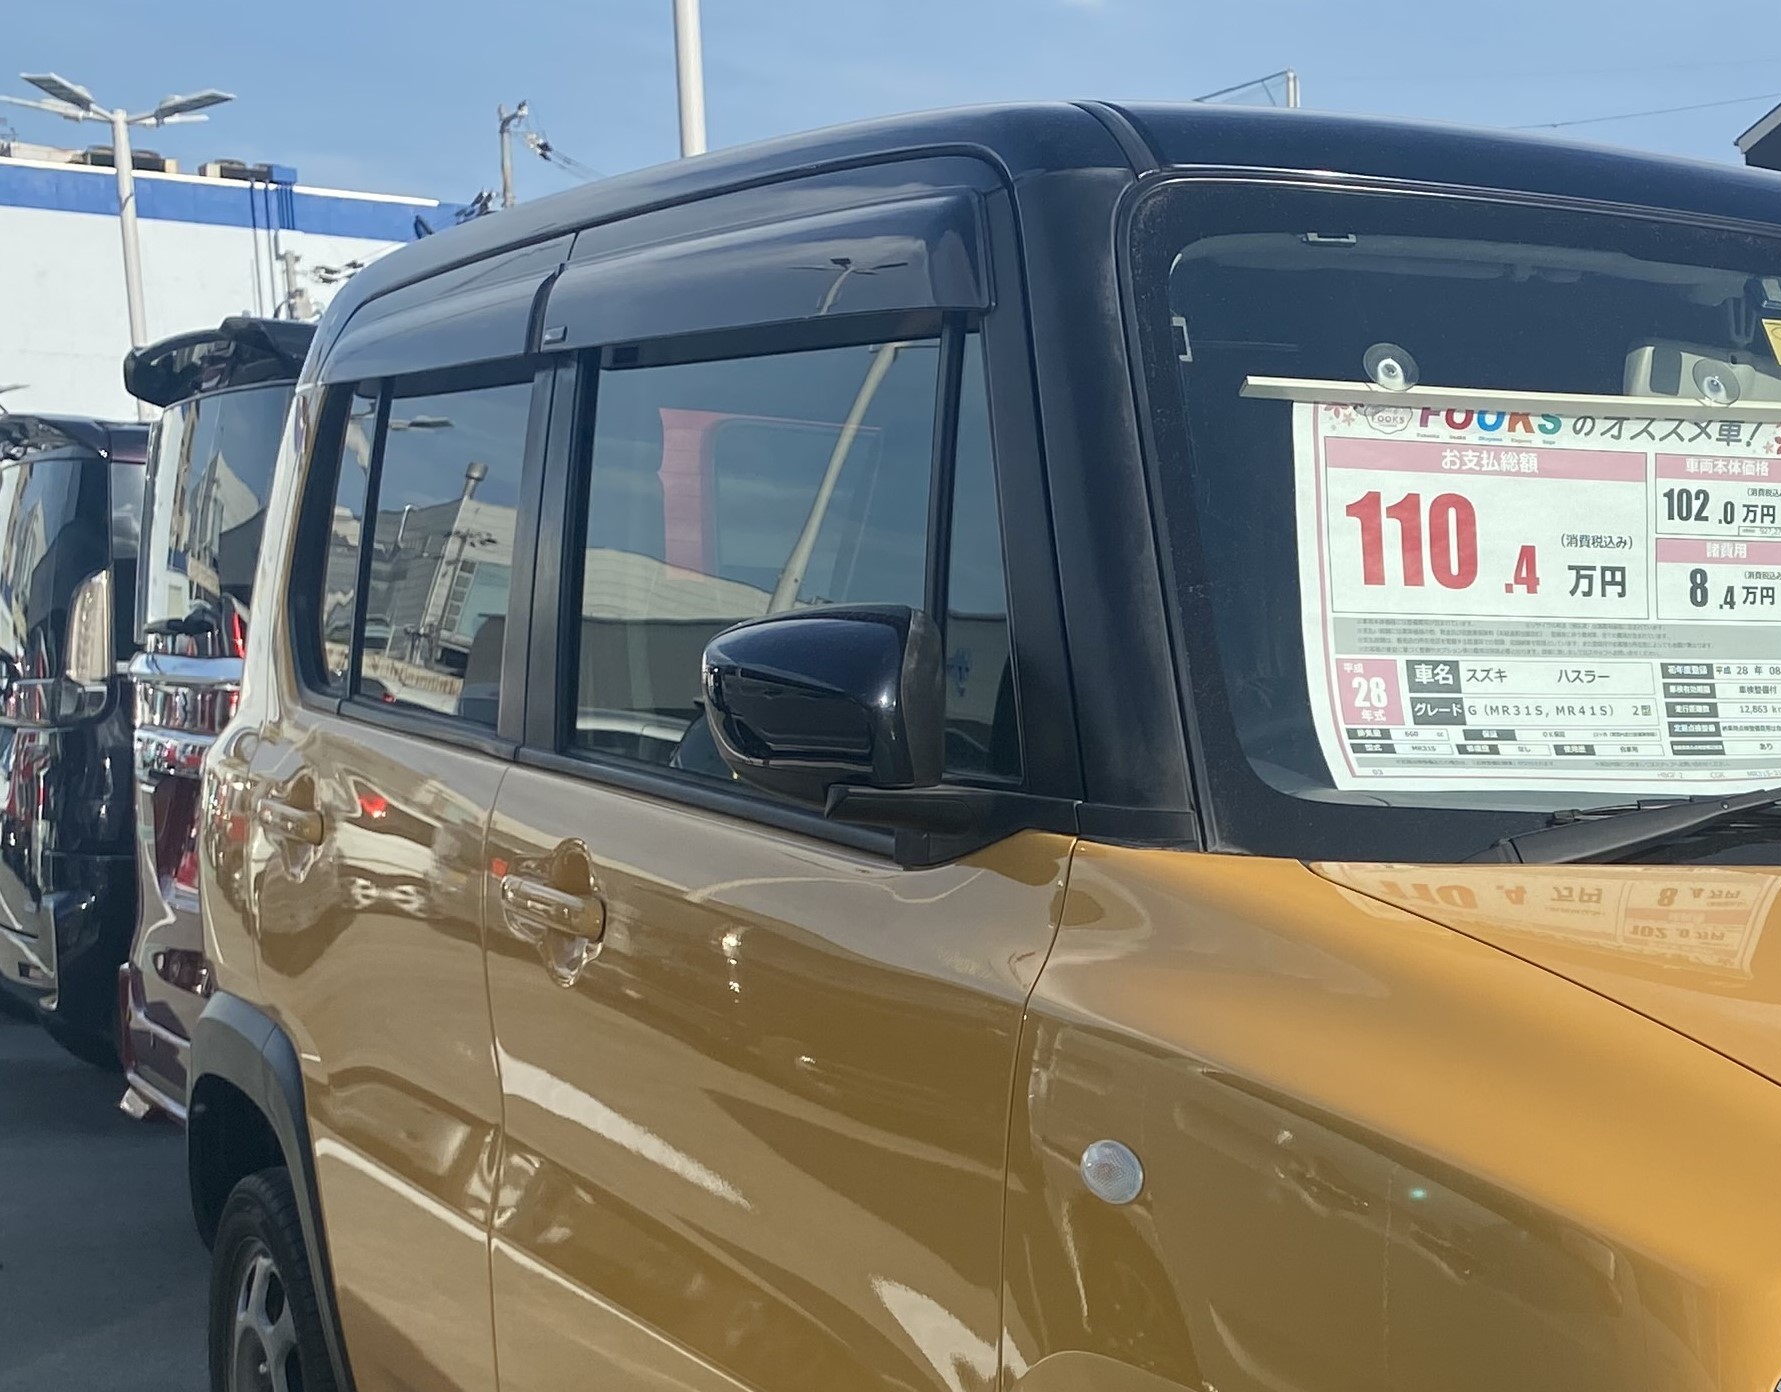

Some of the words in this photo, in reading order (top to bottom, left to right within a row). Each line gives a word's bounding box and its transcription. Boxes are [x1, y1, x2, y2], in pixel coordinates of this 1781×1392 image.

[1441, 449, 1539, 474] お支払総額
[1685, 458, 1770, 477] 車両本体価格
[1663, 488, 1710, 522] 102
[1742, 503, 1776, 524] 万円
[1346, 491, 1478, 590] 110
[1567, 564, 1627, 598] 万円
[1560, 533, 1634, 550] (消費税込み)
[1689, 568, 1709, 608] 8
[1742, 586, 1776, 606] 万円
[1414, 663, 1454, 685] 車名
[1466, 668, 1508, 684] スズキ
[1557, 669, 1610, 684] ハスラー
[1736, 666, 1748, 676] 28
[1352, 676, 1388, 708] 28
[1361, 710, 1387, 722] 年式
[1414, 702, 1463, 717] グレード
[1468, 705, 1478, 716] G
